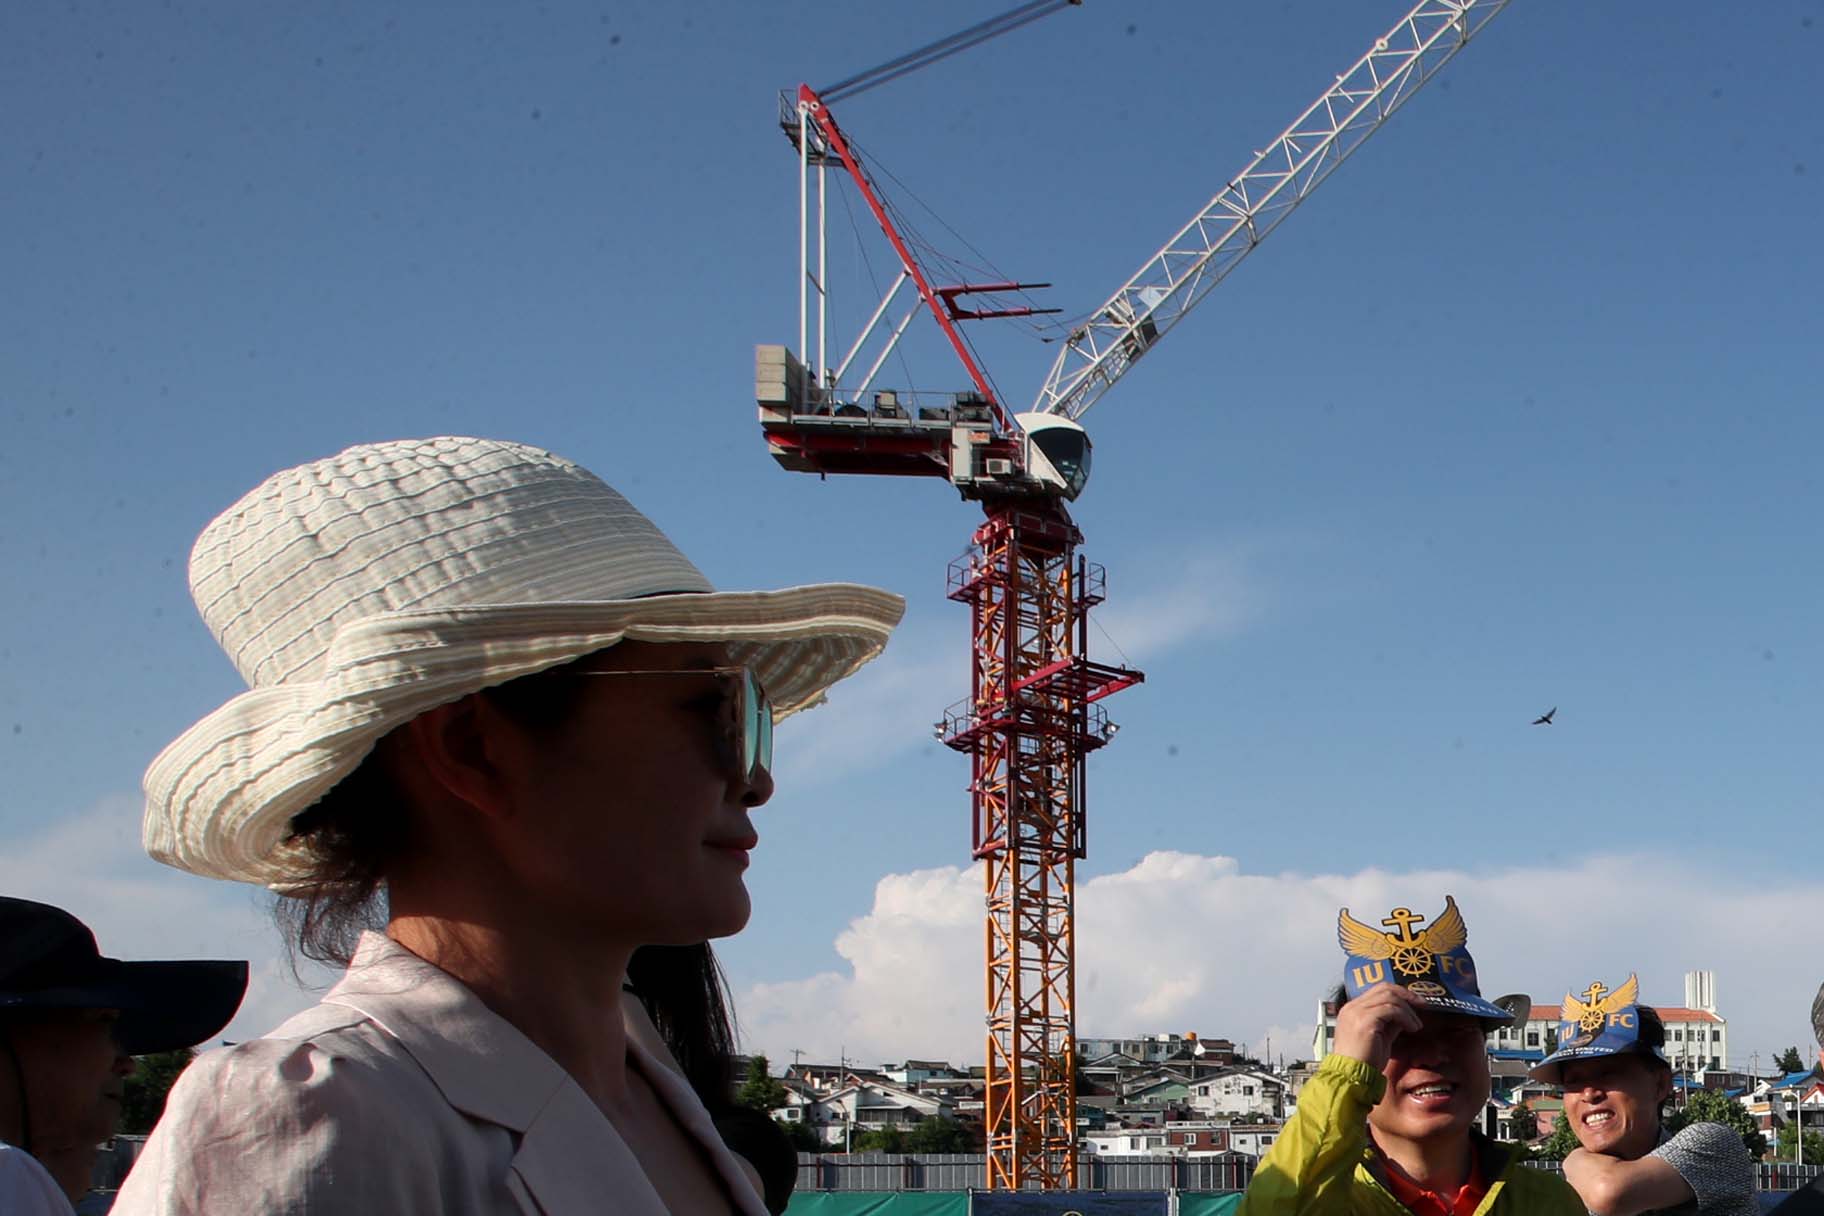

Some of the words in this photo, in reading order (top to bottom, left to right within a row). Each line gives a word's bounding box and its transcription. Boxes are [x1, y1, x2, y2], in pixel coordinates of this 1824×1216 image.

[1353, 961, 1385, 988] IU
[1561, 1023, 1575, 1043] IU
[1608, 1013, 1634, 1028] FC
